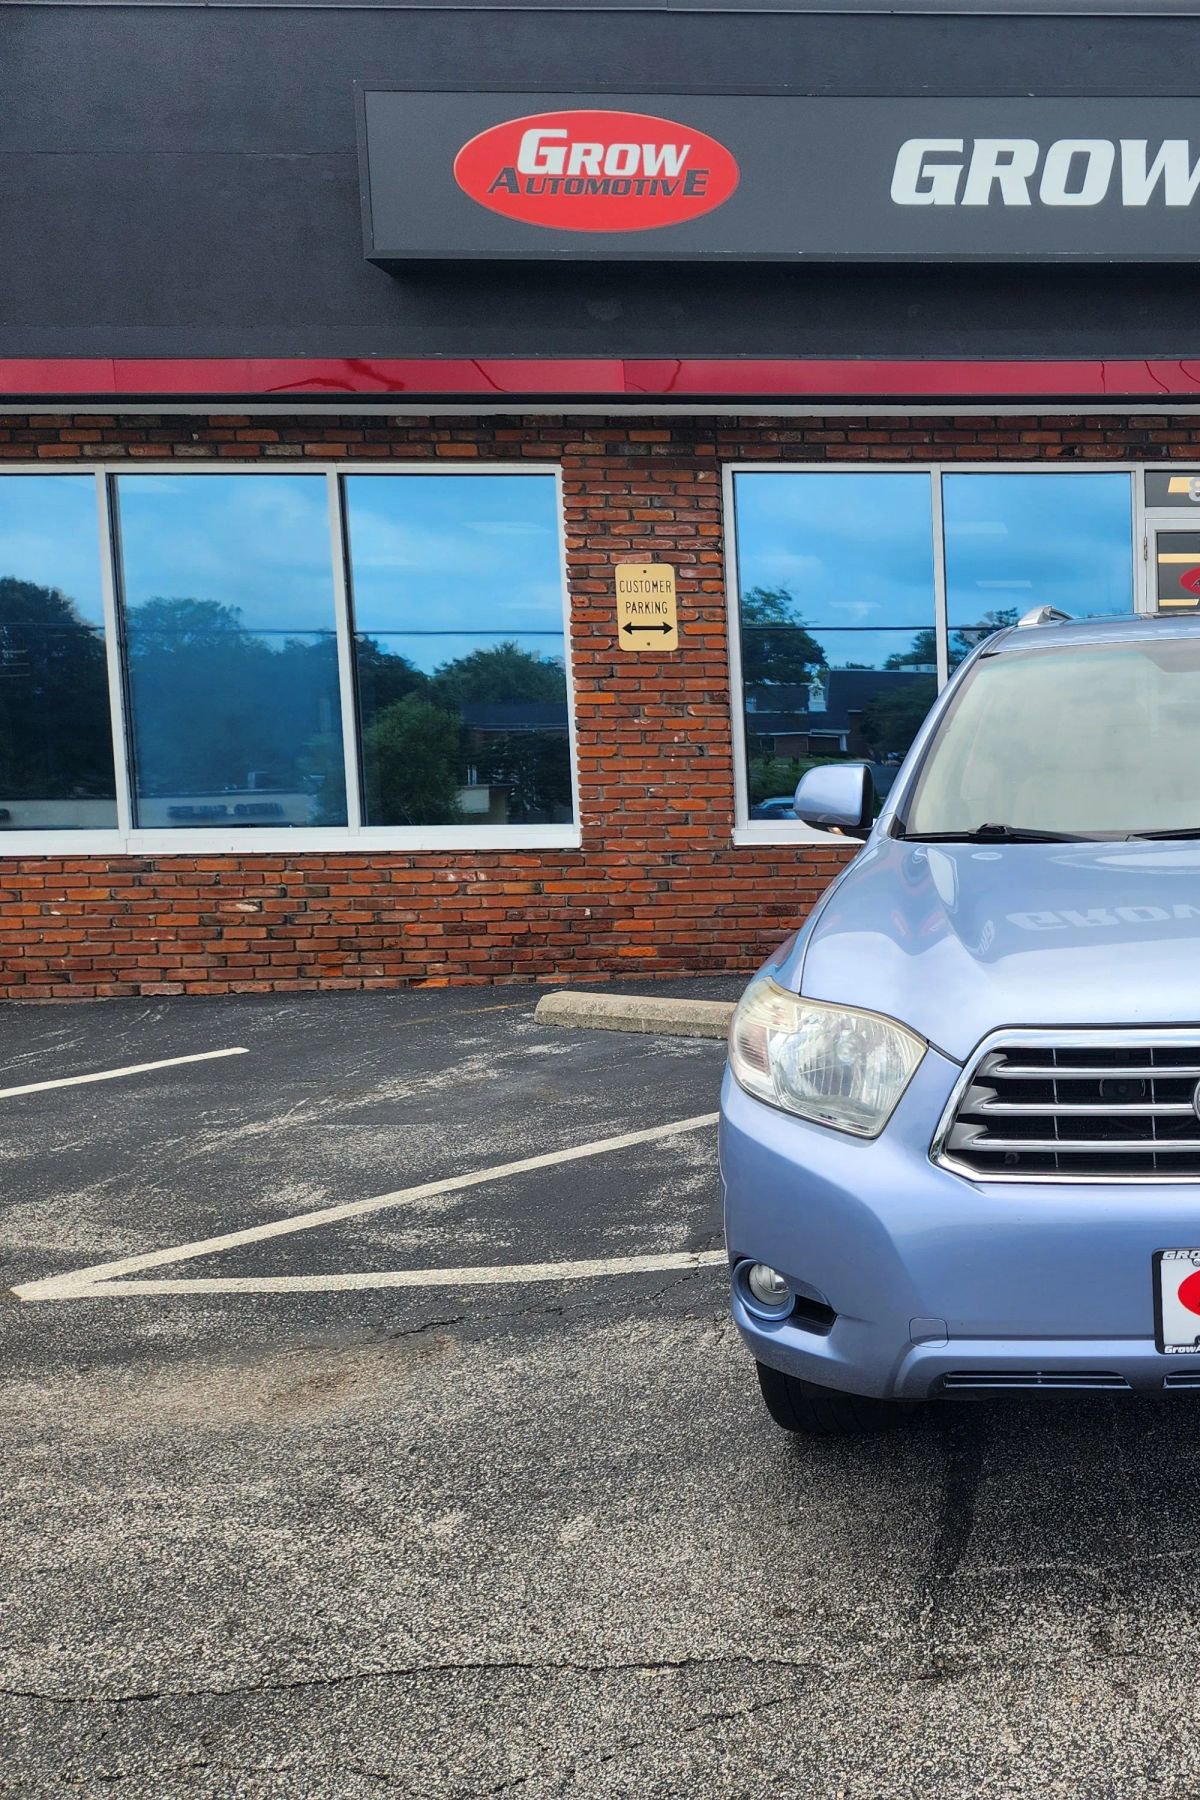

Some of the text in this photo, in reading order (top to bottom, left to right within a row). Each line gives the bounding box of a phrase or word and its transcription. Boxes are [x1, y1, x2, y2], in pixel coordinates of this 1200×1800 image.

[517, 128, 691, 177] GROW
[487, 167, 709, 197] AUTOMOTIVE
[619, 580, 672, 593] CUSTOMER
[625, 601, 668, 614] PARKING
